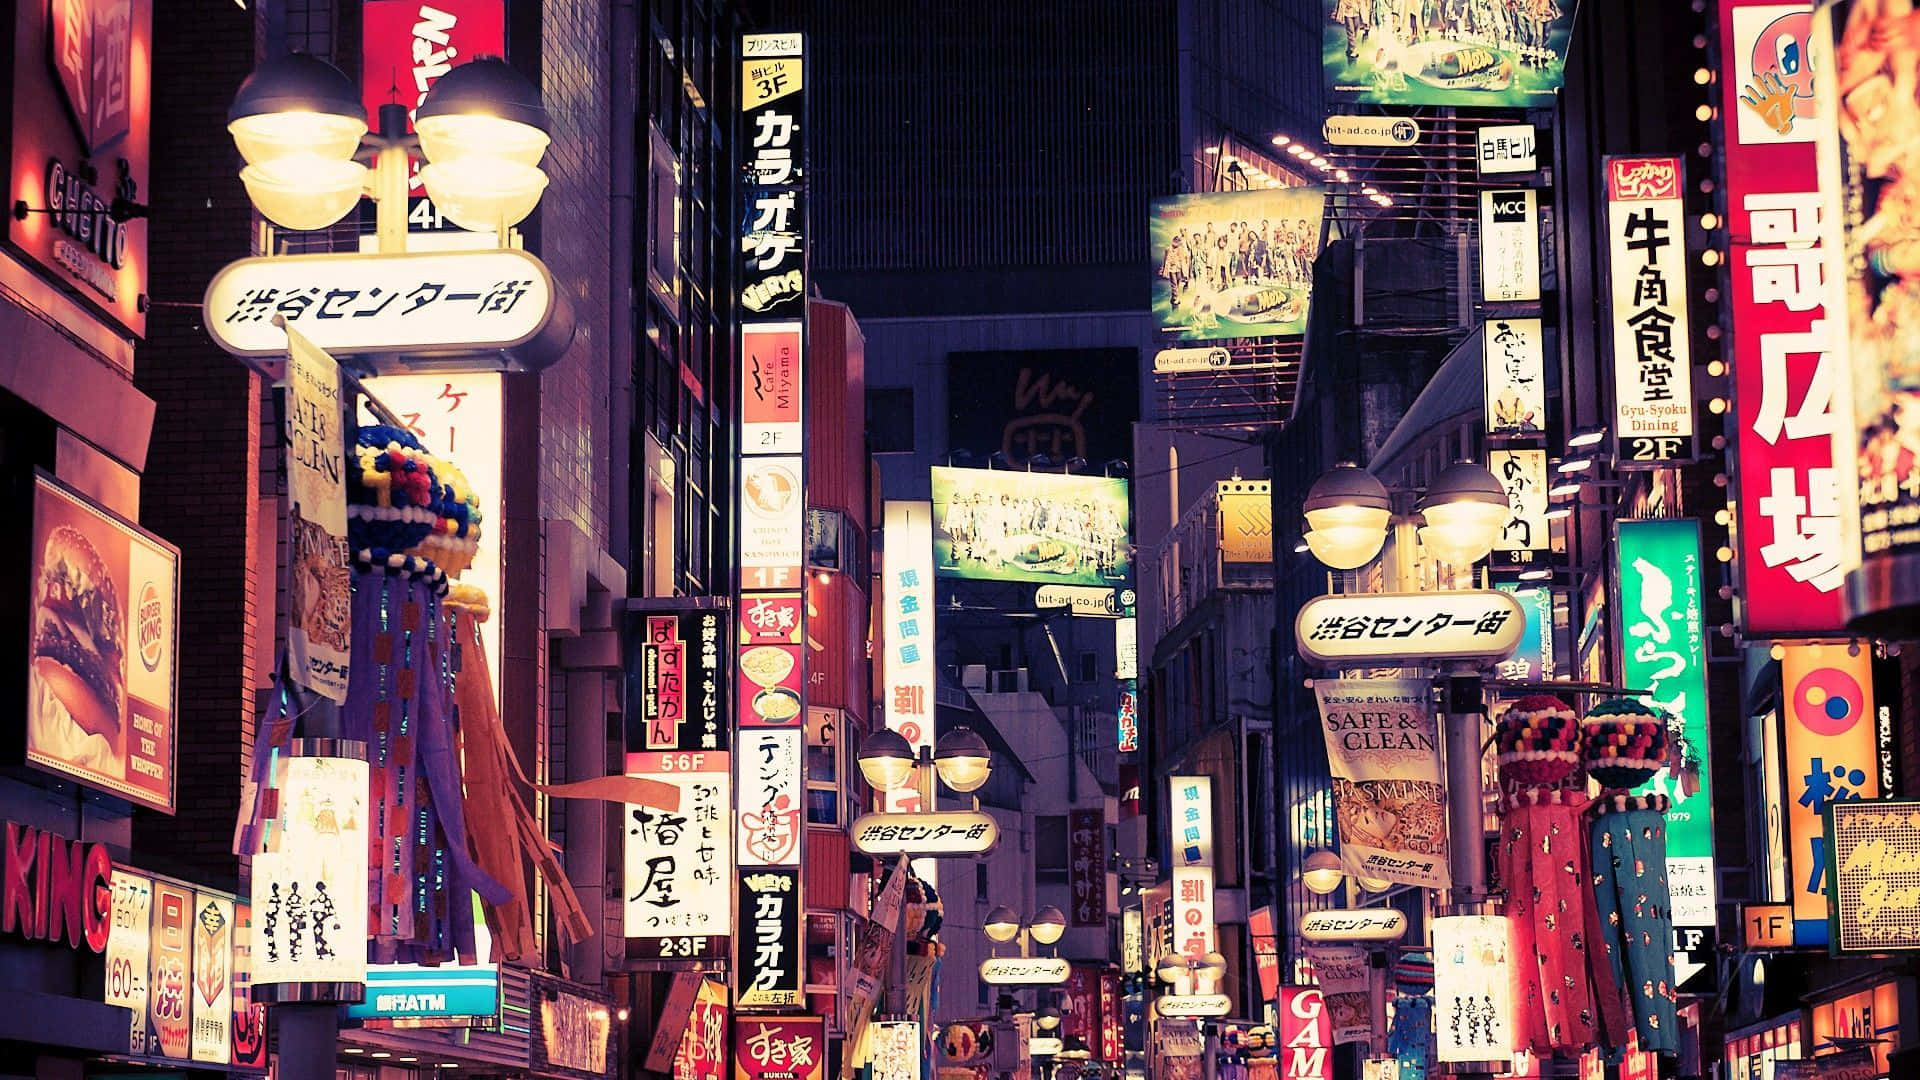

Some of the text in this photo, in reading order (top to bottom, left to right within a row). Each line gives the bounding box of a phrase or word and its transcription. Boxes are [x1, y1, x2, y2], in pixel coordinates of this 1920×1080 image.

[752, 61, 785, 80] 当ビル
[756, 73, 788, 99] 3F
[1327, 125, 1391, 138] hit-ad.co.jp
[1483, 137, 1537, 160] 白馬ビル
[1493, 200, 1526, 215] MCC
[226, 279, 534, 324] 渋谷センター街
[1624, 207, 1676, 402] 牛角食堂
[764, 362, 775, 393] Cafe
[777, 346, 792, 409] Miyama
[1631, 420, 1679, 434] Dining
[760, 431, 783, 446] 2F
[1632, 437, 1683, 460] 2F
[753, 567, 790, 588] 1F
[1038, 593, 1104, 608] hit-ad.co.jp
[747, 598, 795, 632] すき家
[898, 567, 922, 666] 現金問屋
[1310, 610, 1512, 641] 渋谷センター街
[141, 617, 162, 648] KING
[1327, 712, 1418, 731] SAFE &
[1343, 732, 1435, 752] CLEAN
[1667, 811, 1691, 822] 1979
[860, 823, 989, 842] 渋谷センター街
[629, 808, 687, 908] 椿屋
[1367, 855, 1434, 872] 渋谷センター街
[1668, 863, 1707, 876] ステーキ
[3, 820, 112, 954] KING
[1305, 917, 1400, 932] 渋谷センター街
[1752, 917, 1785, 939] 1F
[754, 893, 784, 991] カラオケ
[132, 1030, 145, 1050] 5F
[1286, 989, 1328, 1080] GAM
[746, 1022, 814, 1072] すき家
